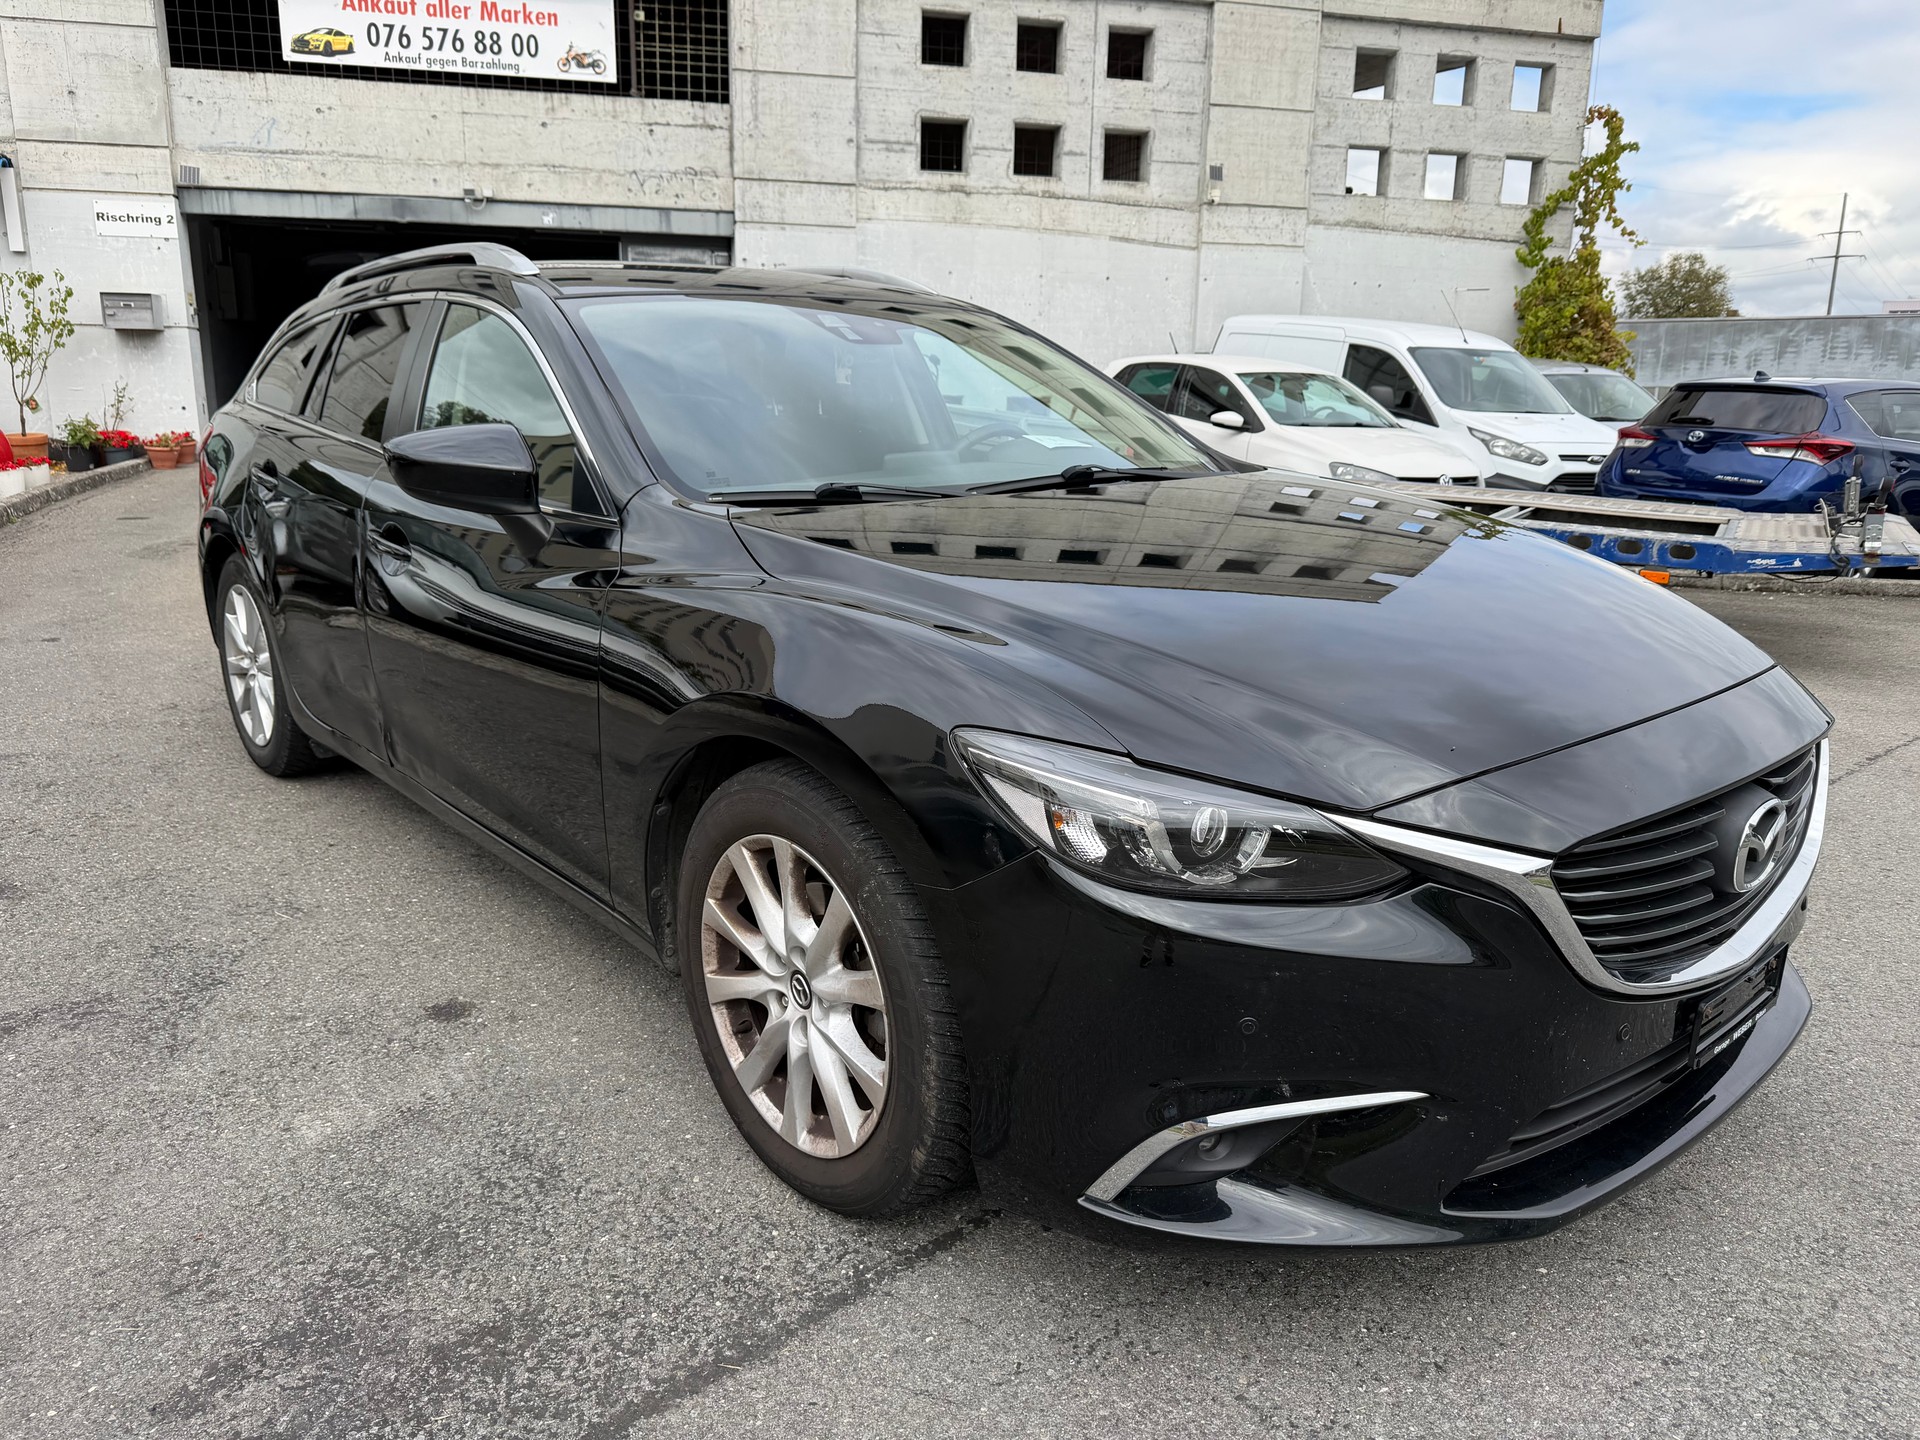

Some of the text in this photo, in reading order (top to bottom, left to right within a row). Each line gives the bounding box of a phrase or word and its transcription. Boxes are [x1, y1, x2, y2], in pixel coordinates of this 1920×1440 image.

[341, 0, 559, 27] Ankauf aller Marken
[366, 22, 539, 58] 076 576 88 00
[384, 52, 520, 74] Ankauf gegen Barzahlung
[96, 211, 175, 226] Rischring 2
